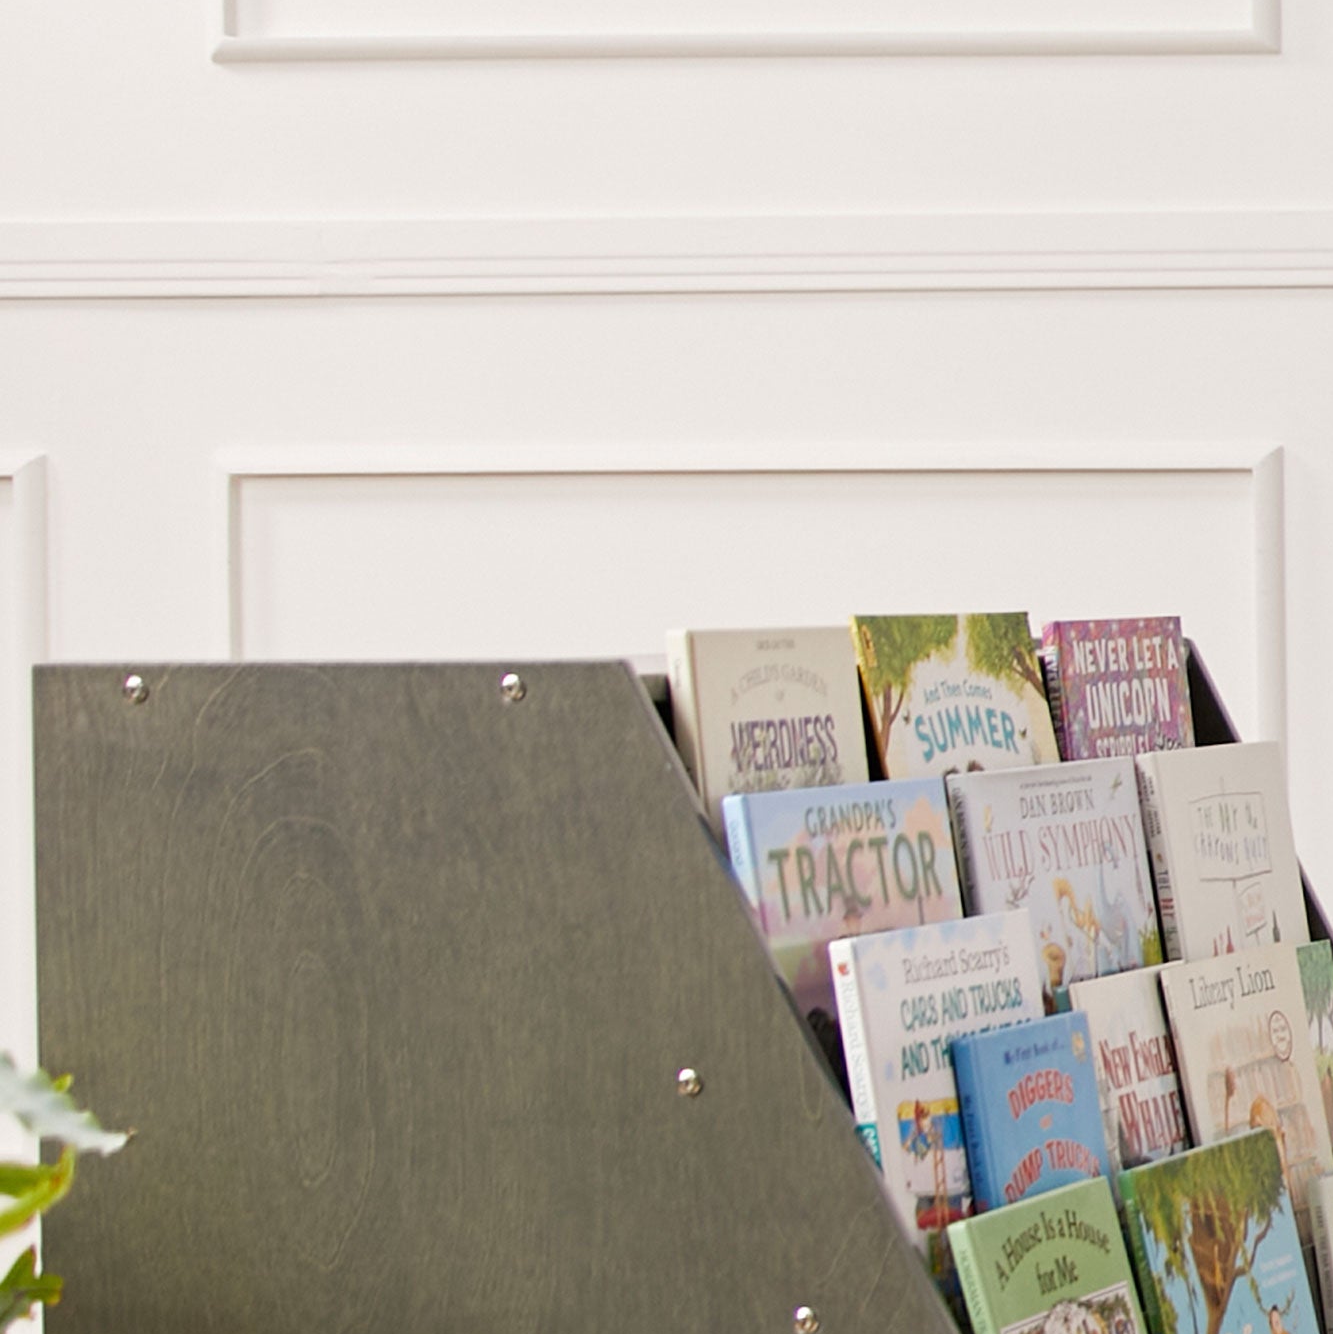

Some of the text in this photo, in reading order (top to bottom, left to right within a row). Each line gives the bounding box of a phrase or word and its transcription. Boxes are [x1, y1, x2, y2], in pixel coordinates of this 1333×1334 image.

[1072, 635, 1179, 674] NEVER LET A
[1085, 677, 1171, 729] UNICORN
[729, 713, 838, 773] WEIRDNESS
[914, 704, 1020, 763] SUMMER
[805, 798, 897, 838] GRANDPA'S
[1019, 788, 1096, 820] DAN BROWN
[982, 814, 1139, 882] WILD SYMPHONY
[768, 830, 943, 923] TRACTOR
[902, 943, 1010, 984] Richard Scarry's
[1189, 964, 1276, 1011] Library Lion
[900, 994, 938, 1031] CARS
[941, 986, 968, 1026] AND
[968, 977, 1023, 1016] TRUCKS
[902, 1039, 930, 1081] AND
[1098, 1038, 1133, 1090] NEW
[1007, 1068, 1075, 1120] DIGGERS
[1118, 1090, 1185, 1157] WHALE
[1004, 1148, 1043, 1204] DUMP
[995, 1209, 1111, 1292] A House Is a House
[1036, 1254, 1079, 1296] for Me
